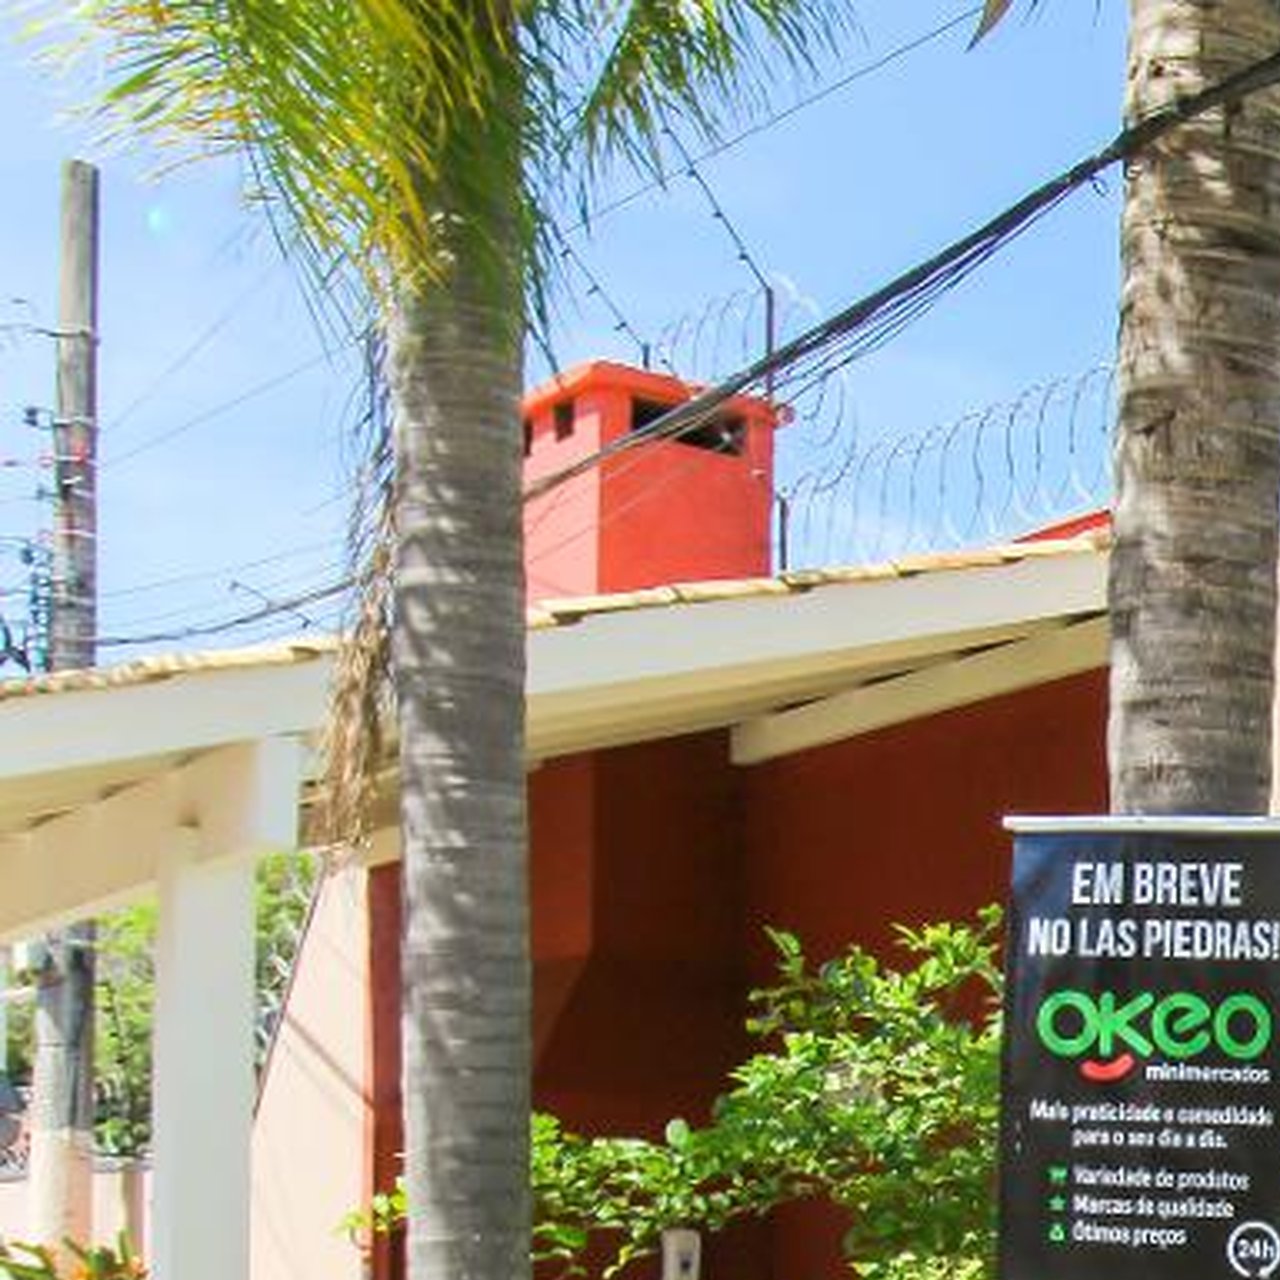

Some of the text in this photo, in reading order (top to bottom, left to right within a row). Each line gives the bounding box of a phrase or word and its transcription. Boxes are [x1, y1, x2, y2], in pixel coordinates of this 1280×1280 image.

[1072, 862, 1244, 905] EM BREVE
[1027, 917, 1280, 960] NO LAS PIEDRAS!
[1145, 1063, 1271, 1082] minimercados
[1072, 1164, 1250, 1191] Variedade de produtos
[1072, 1195, 1235, 1220] Marcas de qualidade
[1072, 1219, 1187, 1249] Ótimos preços
[1237, 1239, 1274, 1260] 24h
